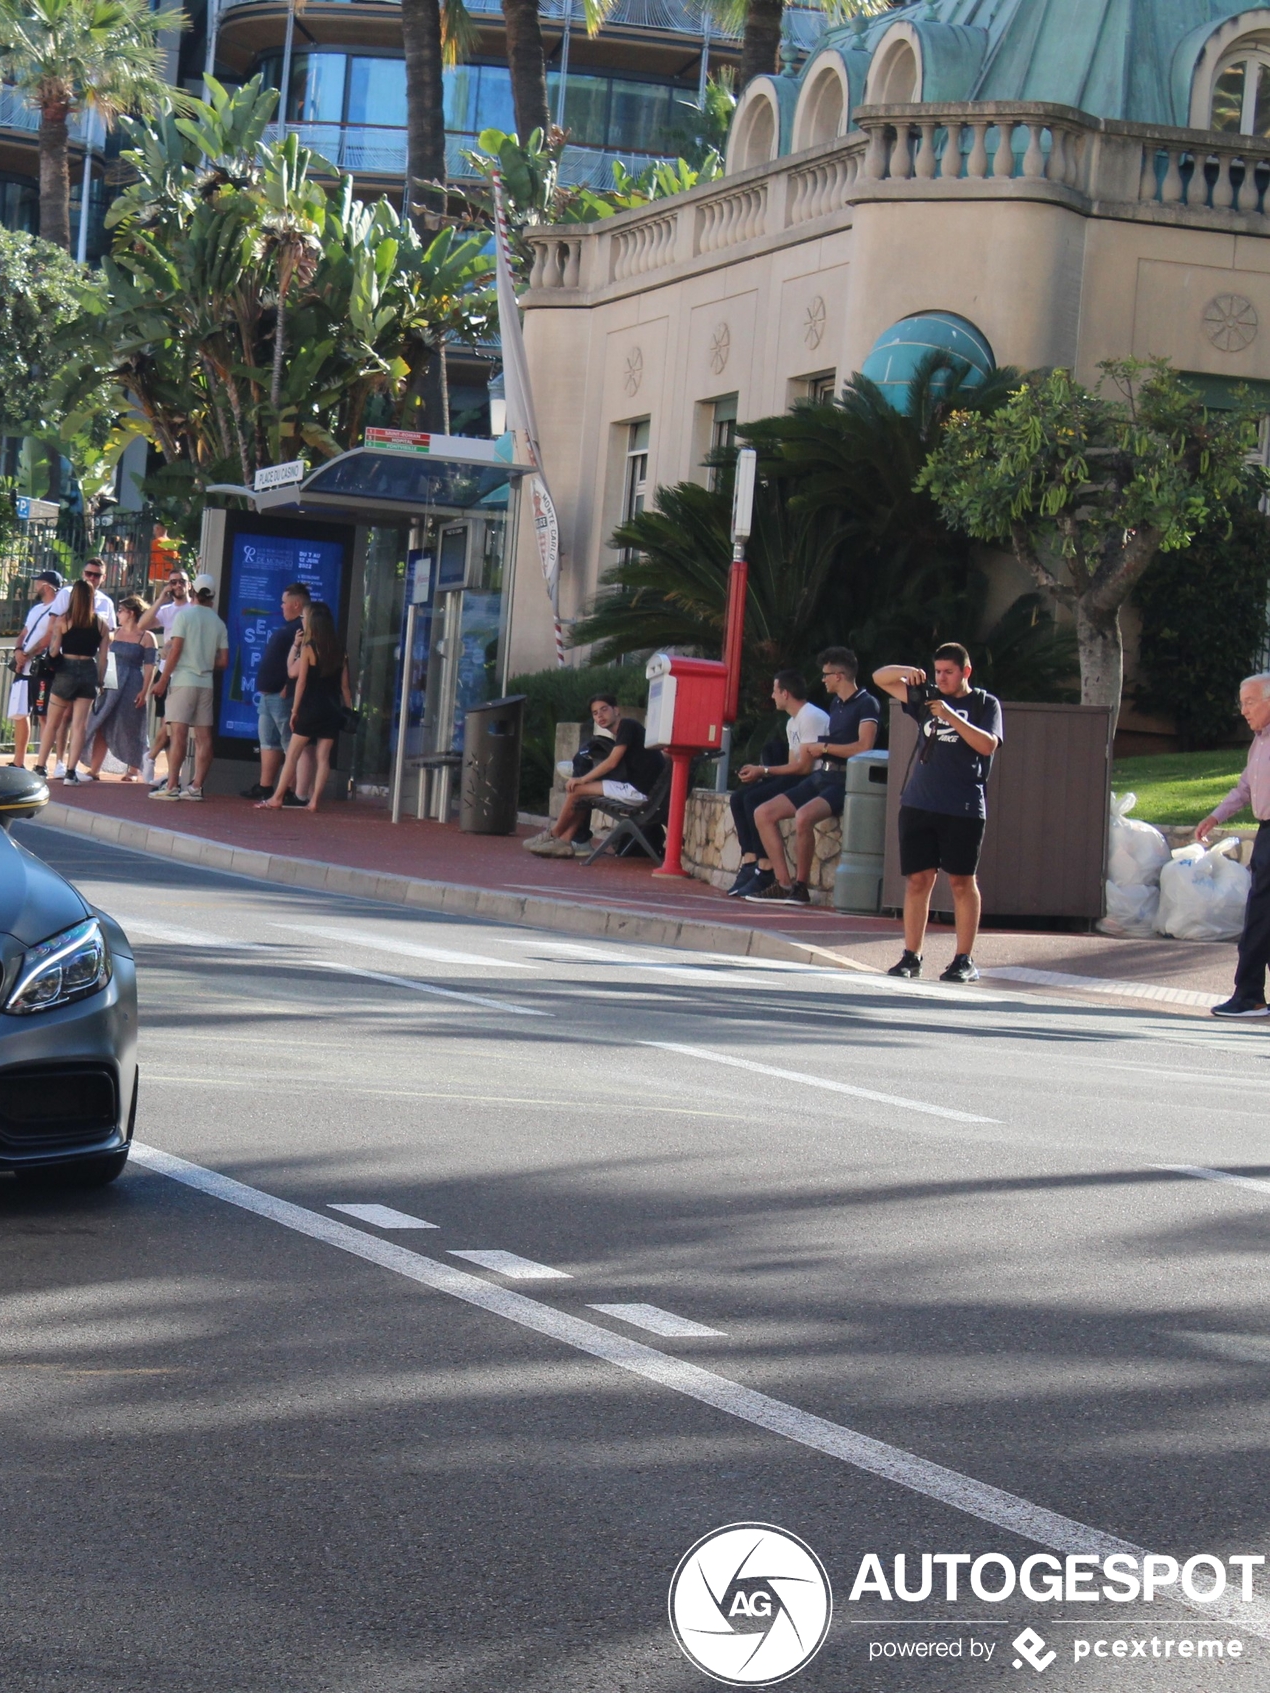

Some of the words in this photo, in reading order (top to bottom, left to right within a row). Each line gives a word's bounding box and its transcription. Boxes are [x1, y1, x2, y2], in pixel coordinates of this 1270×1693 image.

[259, 471, 273, 486] PLACE
[273, 469, 280, 481] DU
[281, 465, 299, 480] CASINO
